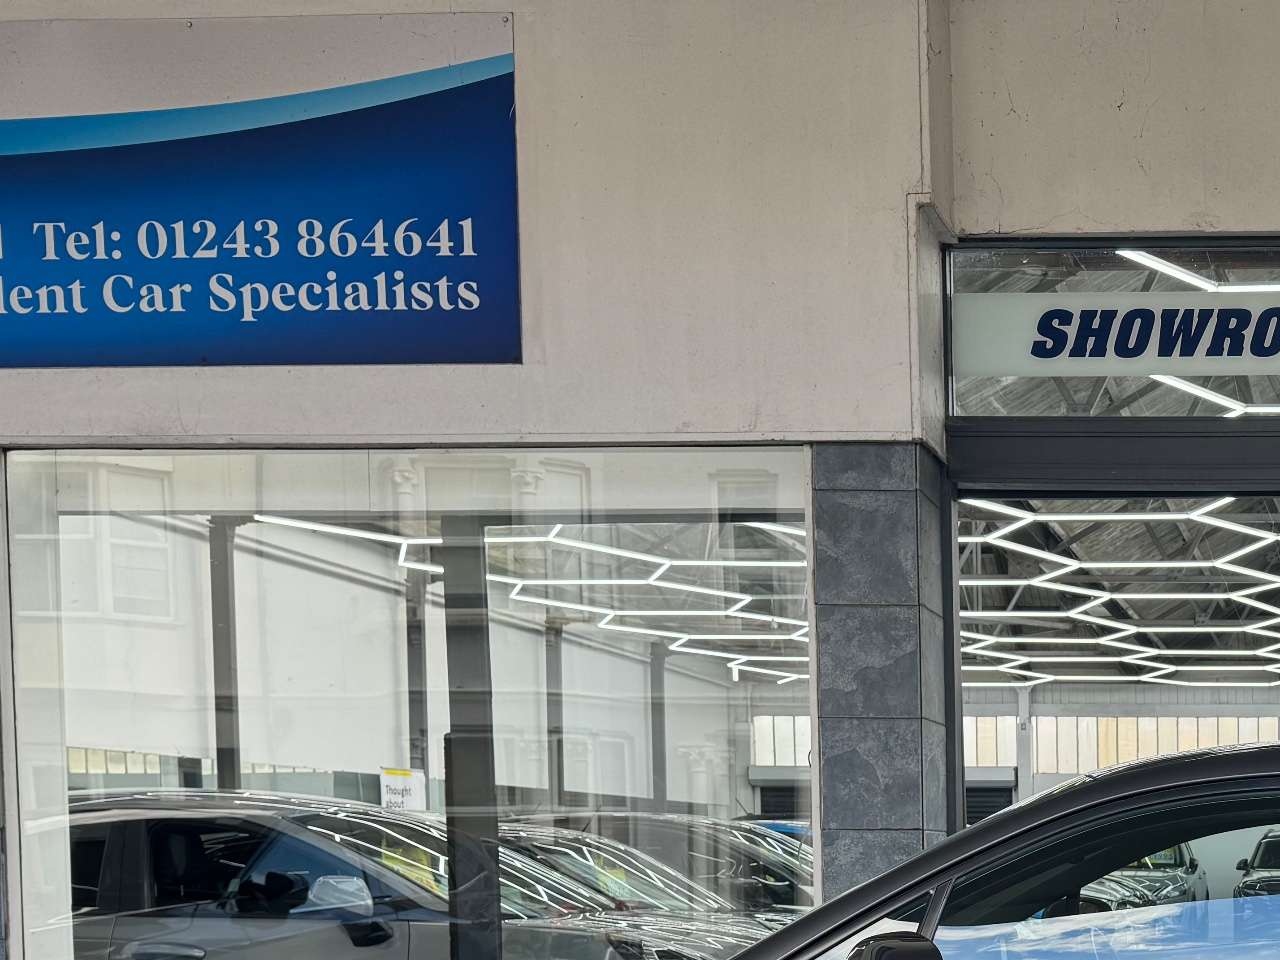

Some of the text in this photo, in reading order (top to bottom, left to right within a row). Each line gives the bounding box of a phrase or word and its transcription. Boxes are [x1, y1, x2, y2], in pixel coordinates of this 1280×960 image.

[33, 220, 122, 260] Tel:
[137, 219, 280, 259] 01243
[297, 217, 478, 258] 864641
[102, 274, 193, 313] Car
[209, 270, 480, 322] Specialists
